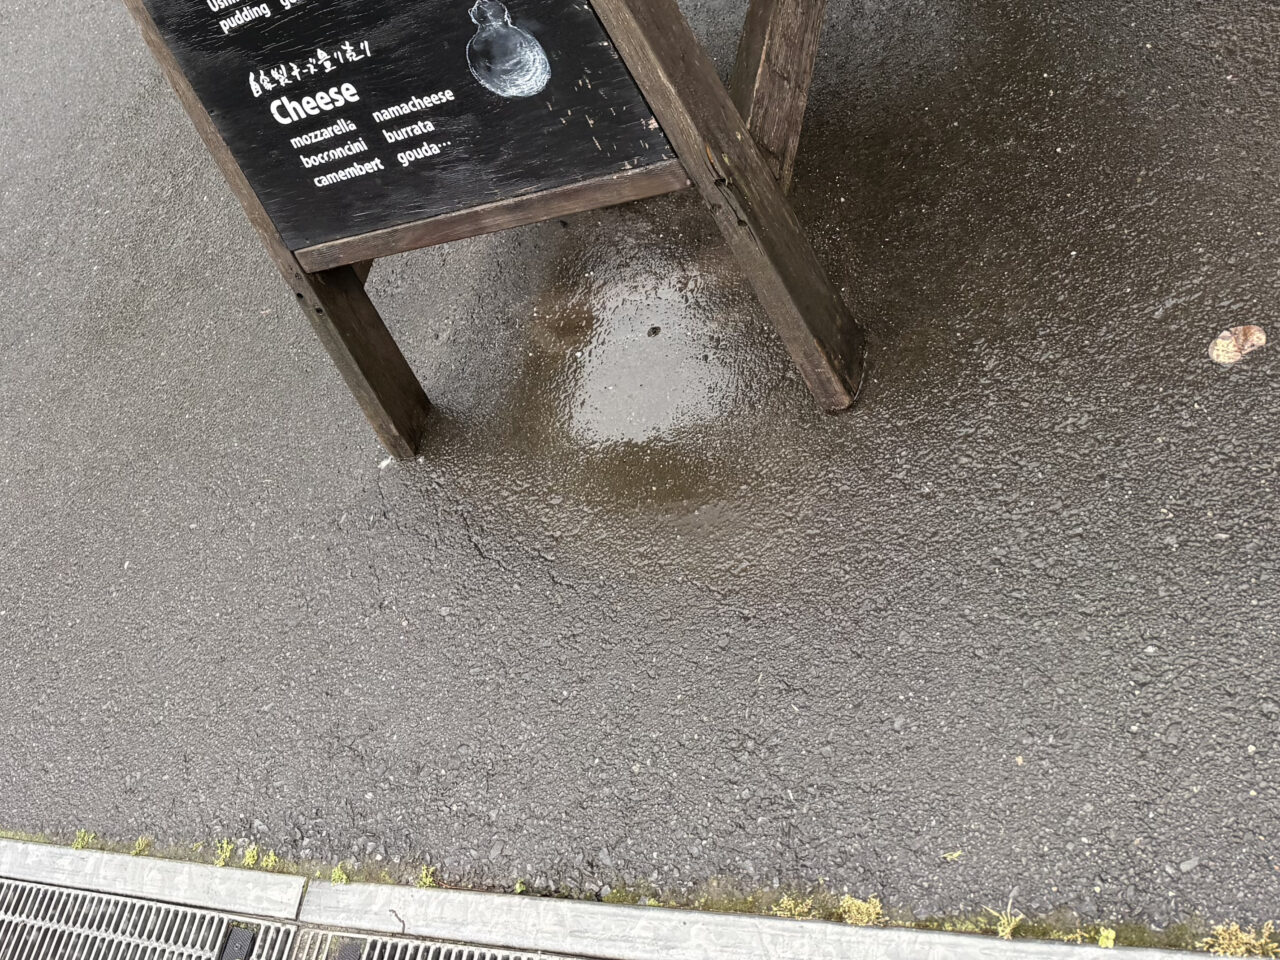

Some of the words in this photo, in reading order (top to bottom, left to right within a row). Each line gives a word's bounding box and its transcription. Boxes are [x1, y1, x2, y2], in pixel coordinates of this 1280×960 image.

[218, 2, 271, 35] pudding
[270, 82, 360, 125] Cheese
[290, 117, 357, 149] mozzarella
[371, 88, 455, 123] namacheese
[299, 137, 368, 169] bocconcini
[382, 119, 435, 143] burrata
[313, 157, 384, 187] camembert
